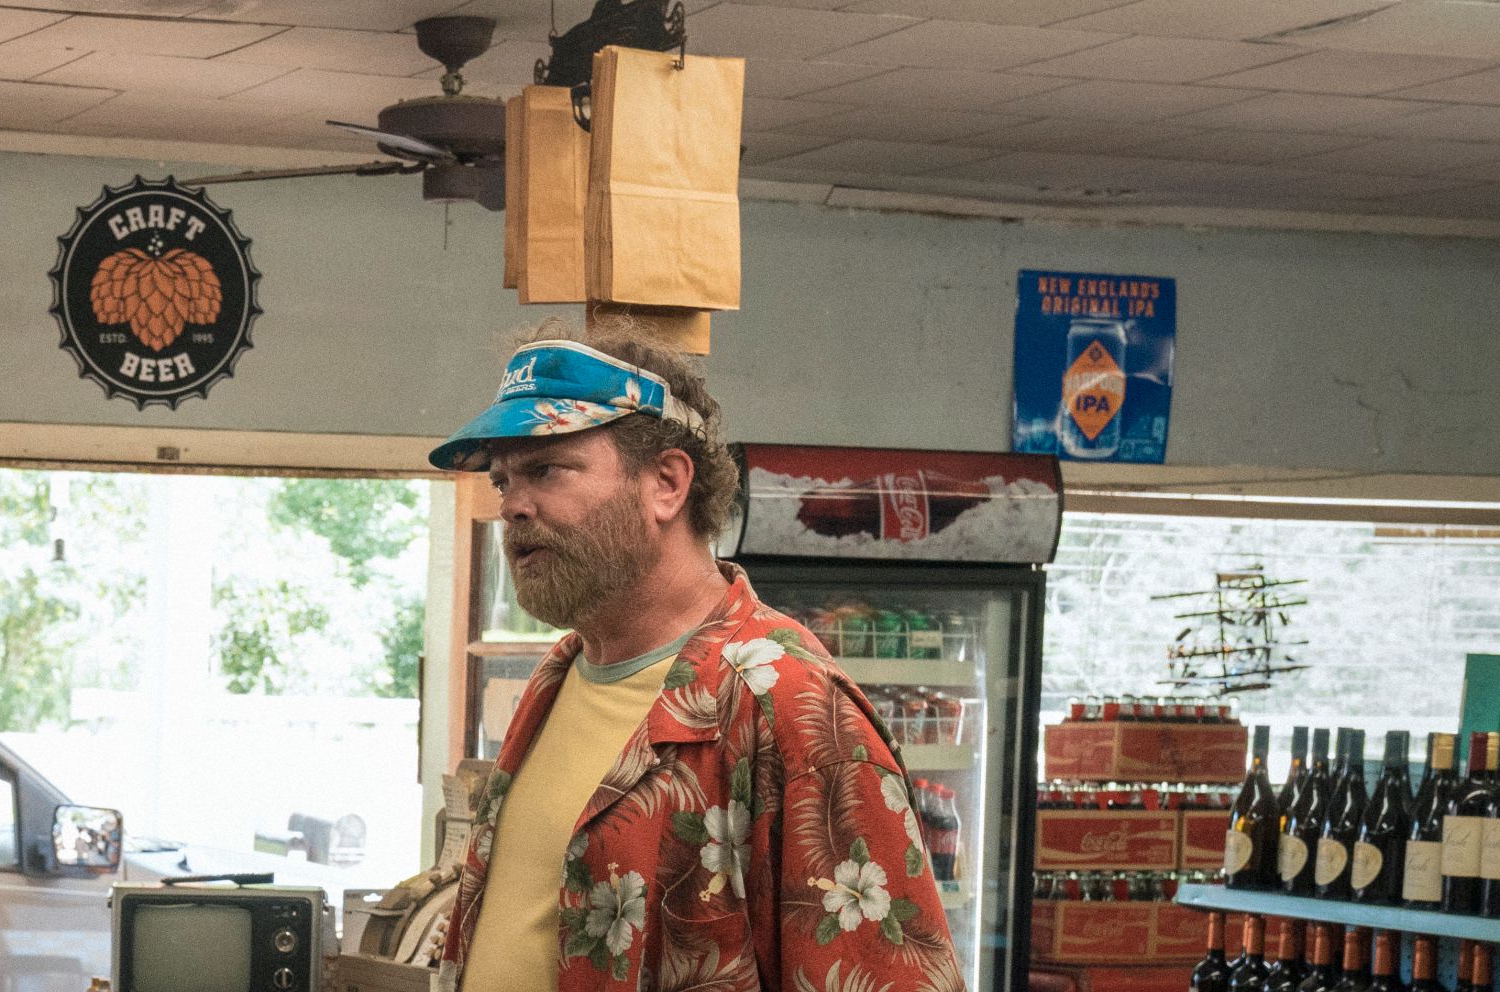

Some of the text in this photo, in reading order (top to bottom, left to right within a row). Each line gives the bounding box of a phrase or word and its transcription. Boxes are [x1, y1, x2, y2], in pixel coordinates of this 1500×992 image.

[107, 204, 207, 241] CRAFT
[1038, 276, 1071, 294] NEW
[1041, 296, 1155, 317] ORIGINAL IPA
[119, 352, 196, 383] BEER
[1076, 395, 1110, 413] IPA
